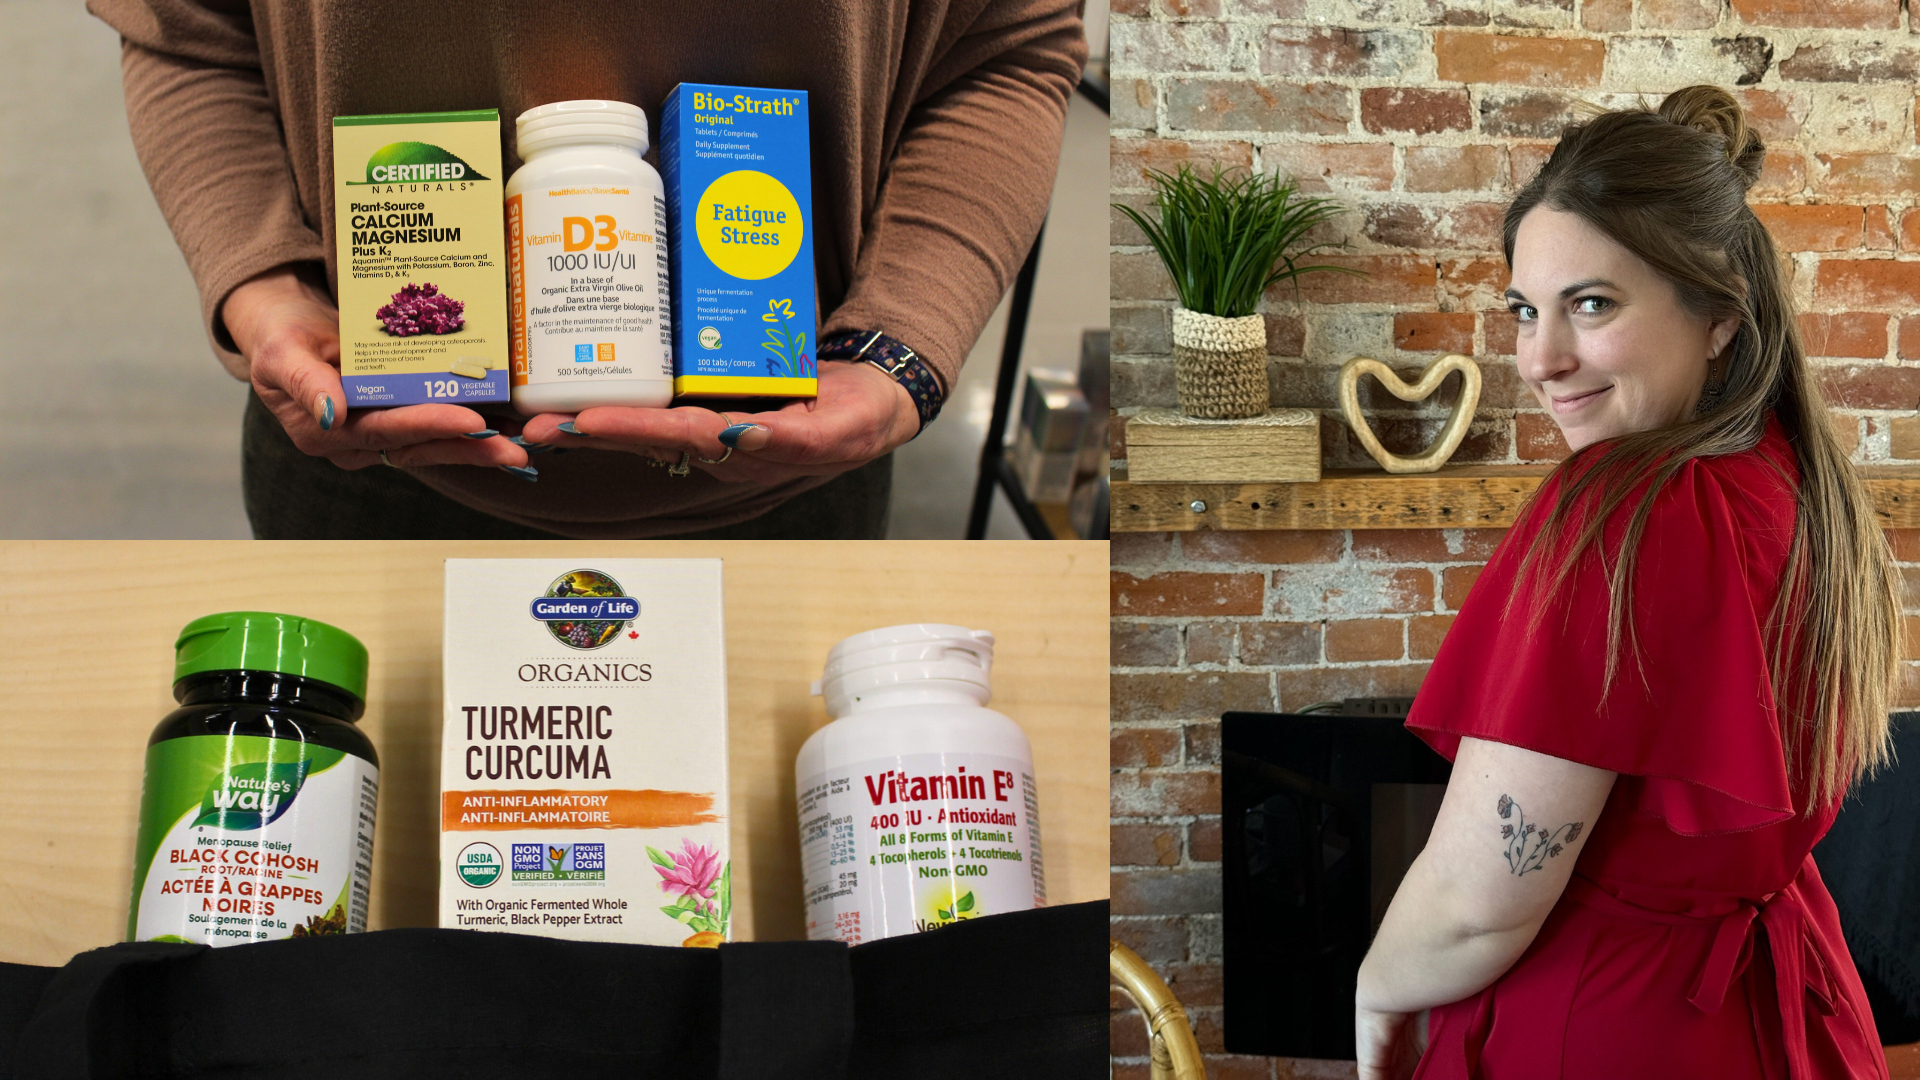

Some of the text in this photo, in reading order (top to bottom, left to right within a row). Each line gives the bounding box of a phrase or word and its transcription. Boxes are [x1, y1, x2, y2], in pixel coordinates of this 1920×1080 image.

[695, 114, 733, 125] Original
[724, 130, 758, 138] Comprimés
[713, 142, 750, 150] Supplement
[372, 163, 465, 182] CERTIFIED
[351, 202, 424, 212] Plant-Source
[352, 213, 433, 229] CALCIUM
[713, 204, 786, 227] Fatigue
[352, 228, 460, 245] MAGNESIUM
[527, 215, 653, 252] Vitamin D3 Vitamine
[721, 227, 780, 245] Stress
[352, 247, 375, 256] Plus
[547, 251, 635, 272] 1000 IU/UI
[542, 287, 568, 296] Organic
[592, 284, 614, 294] Virgin
[531, 306, 550, 315] d'huile
[553, 304, 575, 312] d'olive
[600, 303, 622, 311] vierge
[624, 302, 654, 312] biologique
[574, 366, 632, 376] Softgels/Gélules
[356, 385, 384, 394] Vegan
[424, 380, 458, 397] 120
[537, 601, 633, 617] Garden of Life
[518, 663, 652, 682] ORGANICS
[462, 706, 612, 740] TURMERIC
[466, 746, 611, 780] CURCUMA
[227, 775, 290, 793] Nature's
[864, 766, 986, 806] Vitamin
[213, 790, 280, 818] way
[463, 796, 608, 808] ANTI-INFLAMMATORY
[461, 811, 610, 823] ANTI-INFLAMMATOIRE
[871, 813, 899, 830] 400
[938, 808, 1016, 827] Antioxidant
[198, 837, 292, 853] Menopause Relief
[880, 829, 1013, 847] All 8 Forms of Vitamin E
[515, 846, 540, 854] NON
[576, 852, 603, 860] SANS
[870, 846, 1022, 865] 4 Tocopherols 4 Tocotrienols
[170, 849, 319, 873] BLACK COHOSH
[467, 854, 493, 864] USDA
[514, 854, 540, 863] GMO
[576, 860, 603, 869] OGM
[201, 865, 282, 879] ROOT/RACINE
[464, 867, 496, 876] ORGANIC
[514, 863, 540, 871] Project
[161, 876, 322, 905] ACTÉE À GRAPPES
[202, 898, 275, 916] NOIRES
[457, 898, 628, 913] With Organic Fermented Whole
[189, 914, 287, 929] Soulagement de la
[457, 913, 622, 928] Turmeric, Black Pepper Extract
